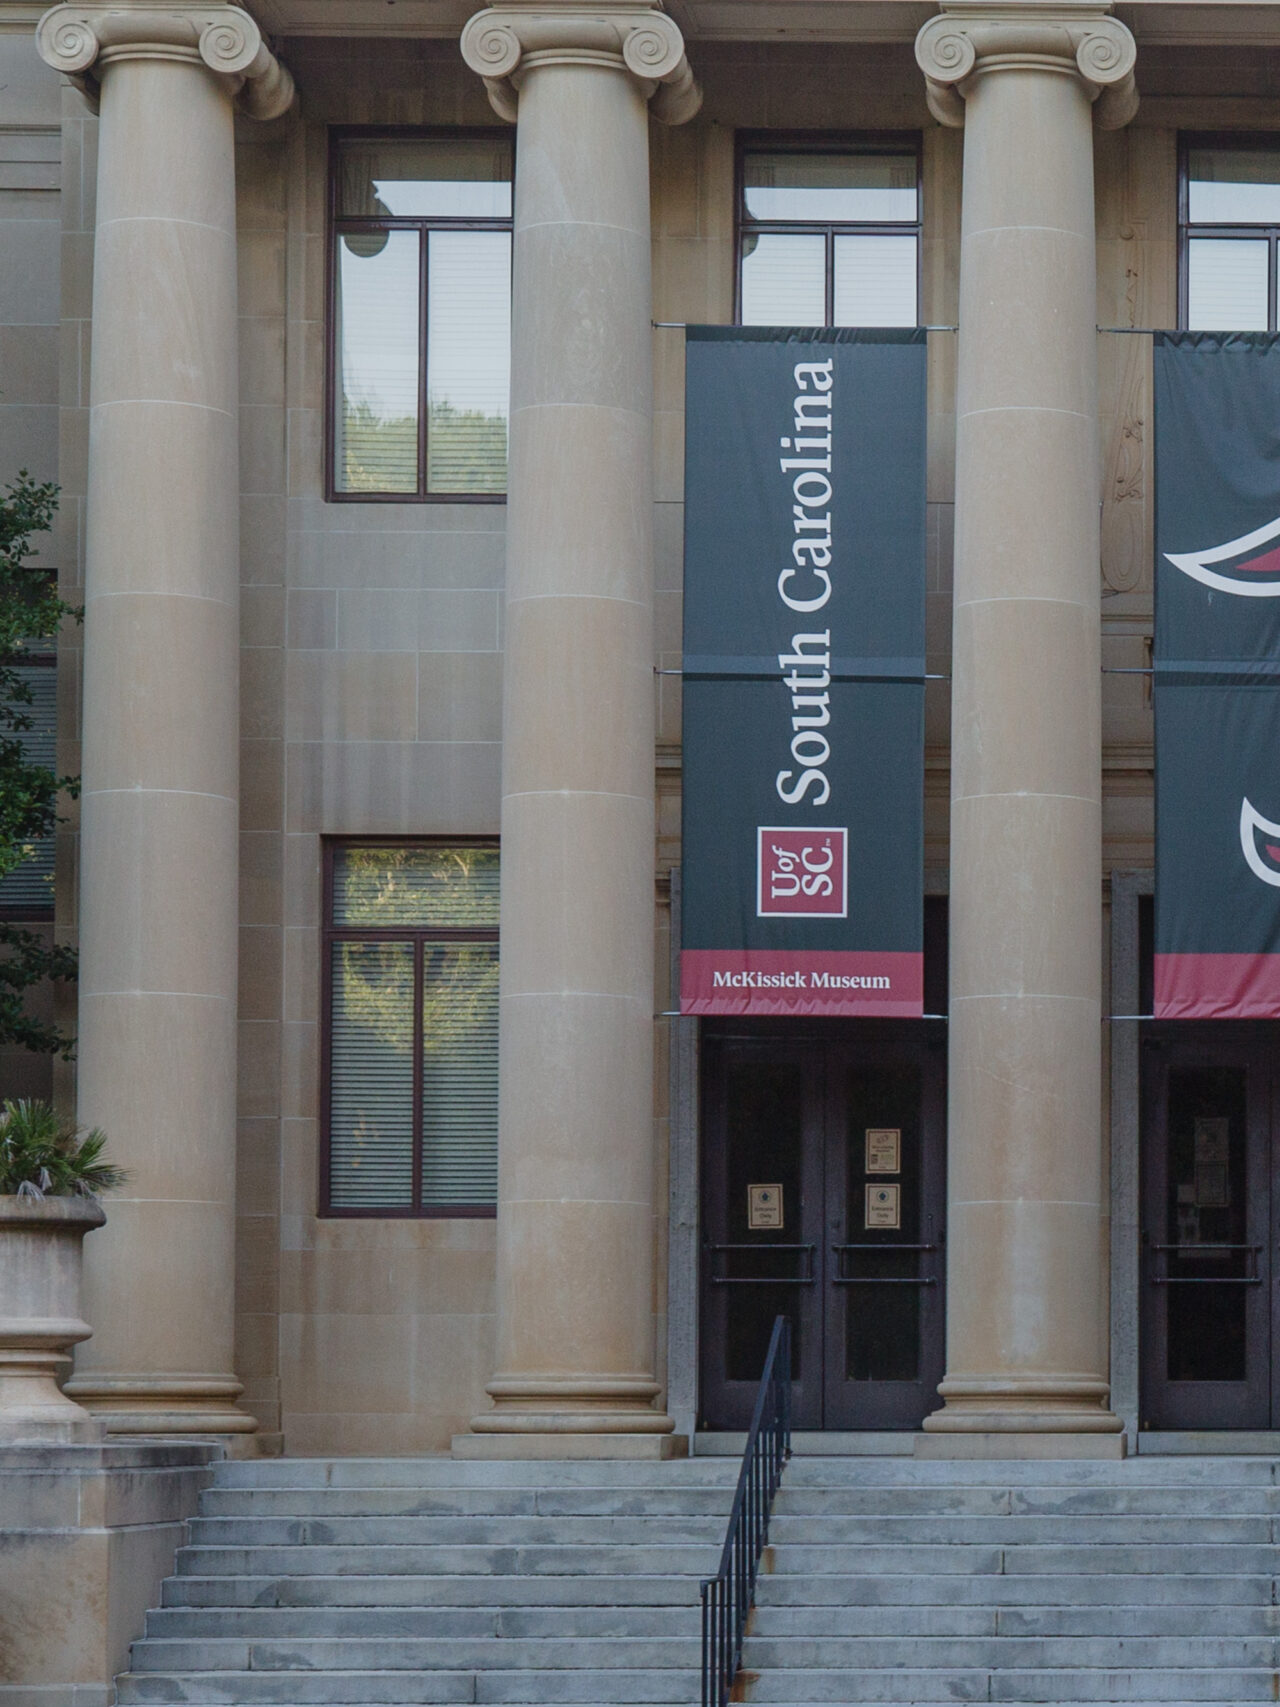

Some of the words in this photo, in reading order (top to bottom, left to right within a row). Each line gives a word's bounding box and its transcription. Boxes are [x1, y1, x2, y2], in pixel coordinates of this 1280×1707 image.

[777, 357, 834, 613] Carolina
[775, 628, 832, 806] South
[713, 971, 807, 988] McKissick
[810, 972, 891, 989] Museum
